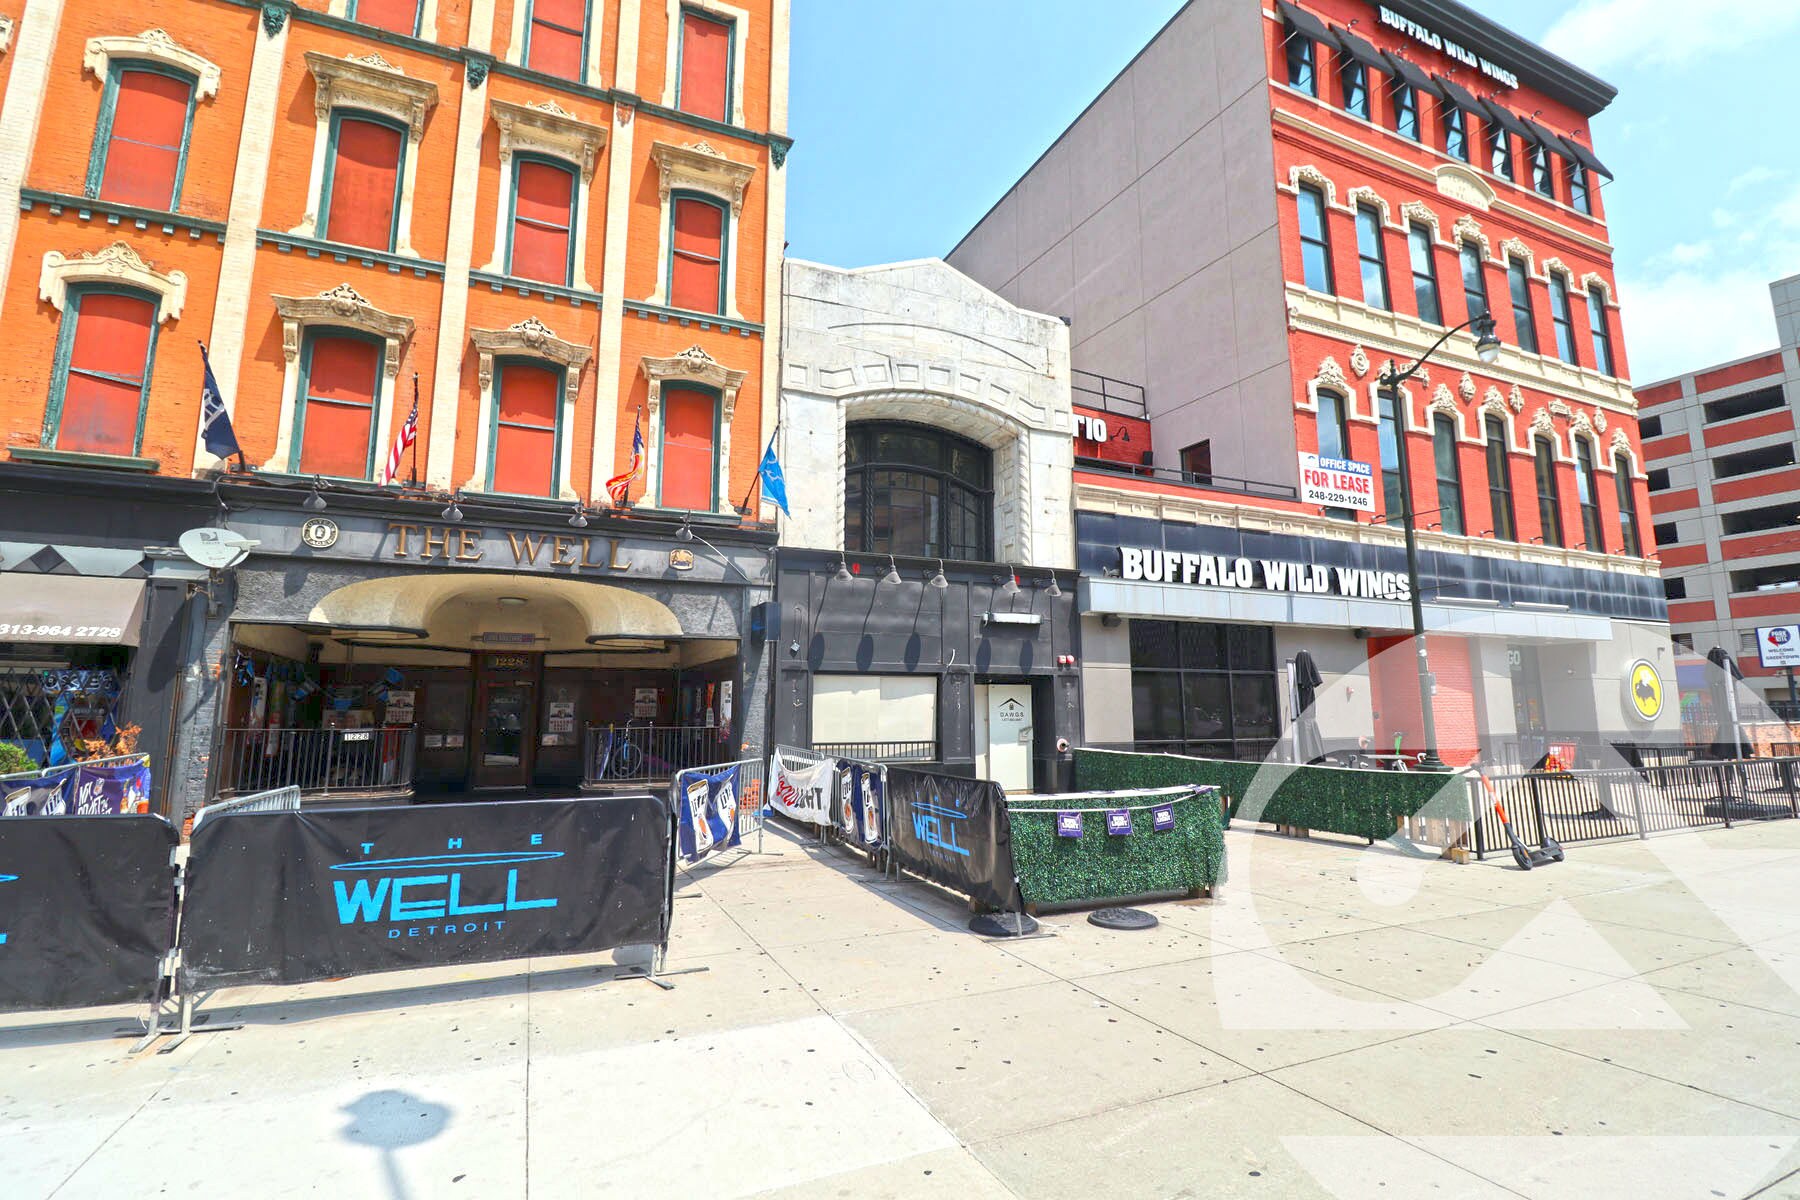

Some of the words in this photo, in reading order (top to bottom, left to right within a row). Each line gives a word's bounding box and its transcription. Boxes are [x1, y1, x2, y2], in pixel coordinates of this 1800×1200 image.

[1379, 5, 1442, 50] BUFFALO
[1443, 38, 1478, 68] WILD
[1479, 56, 1519, 90] WINGS
[1304, 469, 1329, 488] FOR
[1333, 473, 1370, 494] LEASE
[1320, 457, 1347, 470] OFFICE
[1347, 461, 1370, 474] SPACE
[388, 522, 484, 562] THE
[507, 531, 632, 571] WELL
[1119, 547, 1254, 588] BUFFALO
[1257, 559, 1329, 593] WILD
[1332, 567, 1412, 601] WINGS
[74, 626, 121, 638] 2728
[361, 833, 543, 855] THE
[912, 811, 970, 857] WELL
[333, 869, 558, 924] WELL
[388, 920, 506, 939] DETROIT
